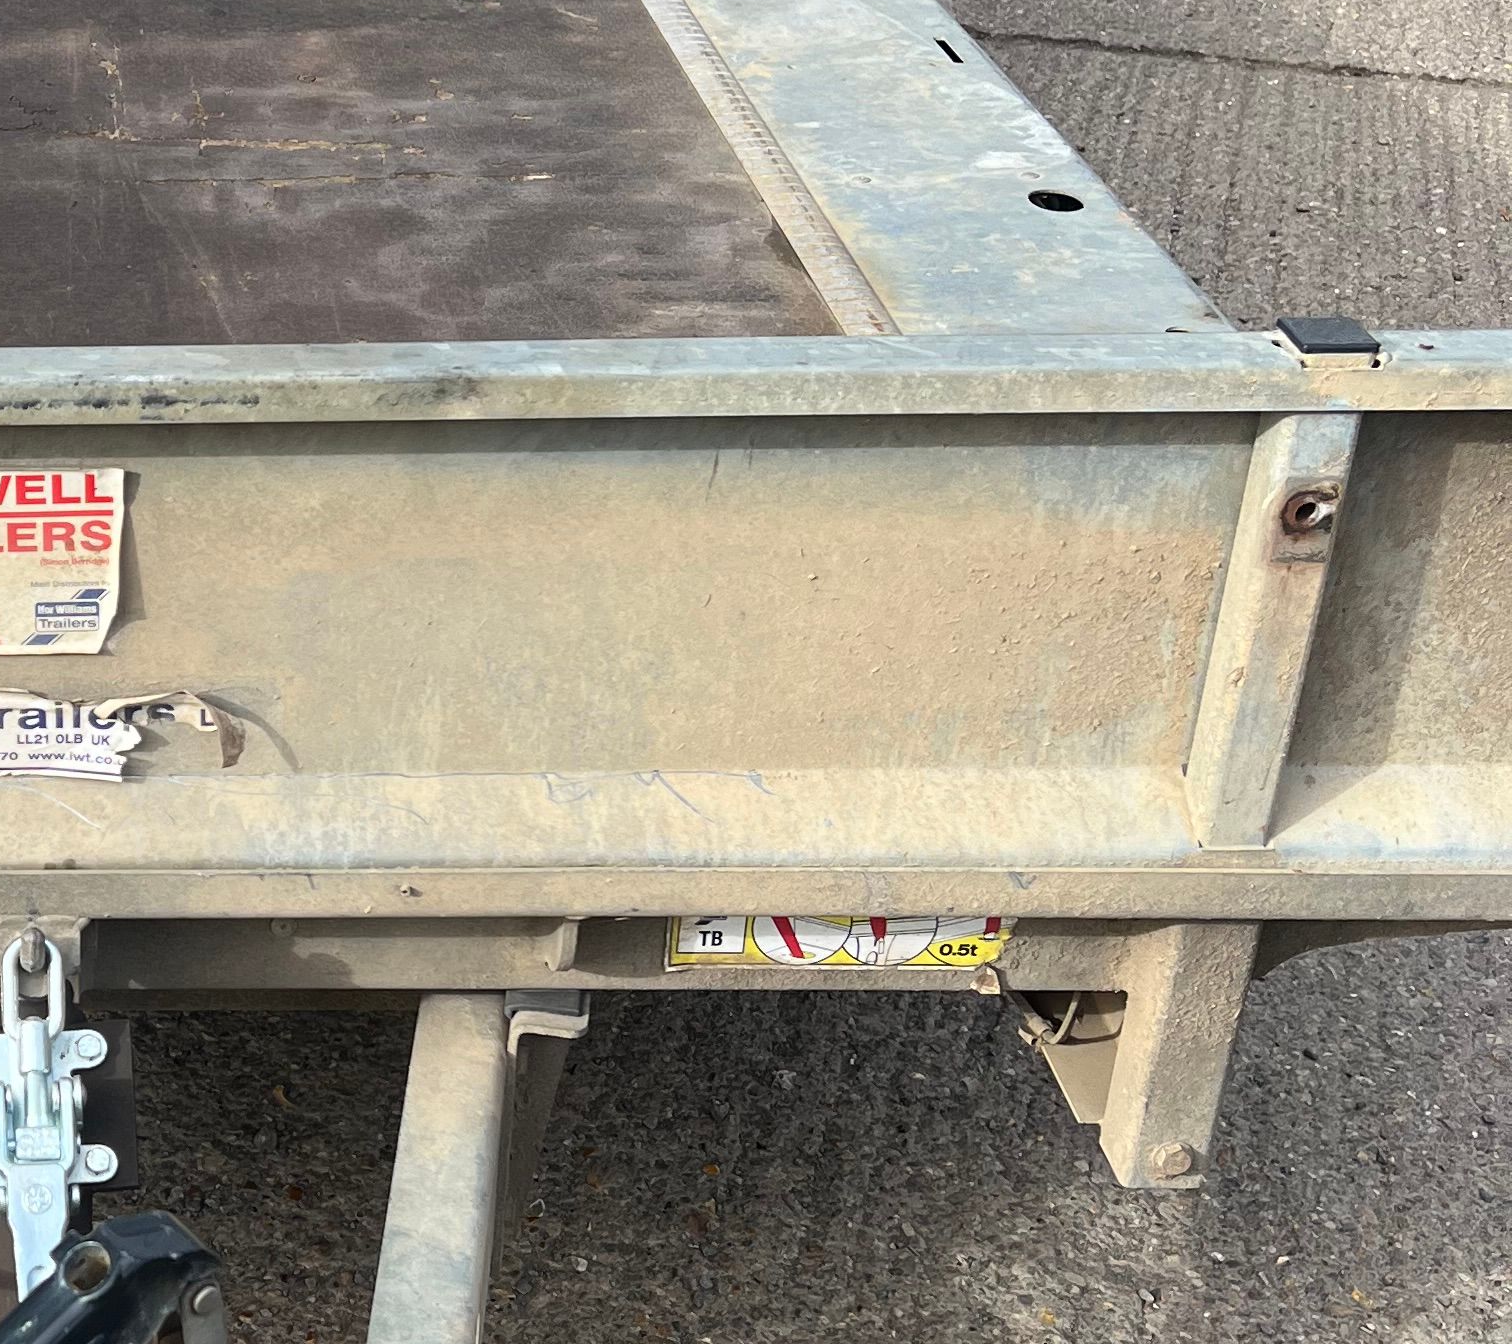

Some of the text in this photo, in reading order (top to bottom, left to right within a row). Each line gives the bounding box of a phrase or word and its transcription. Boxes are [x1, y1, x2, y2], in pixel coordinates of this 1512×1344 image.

[38, 618, 97, 629] Trailers
[16, 734, 49, 745] LL21
[91, 735, 110, 746] UK
[699, 931, 723, 946] TB
[939, 943, 978, 957] 0.5t
